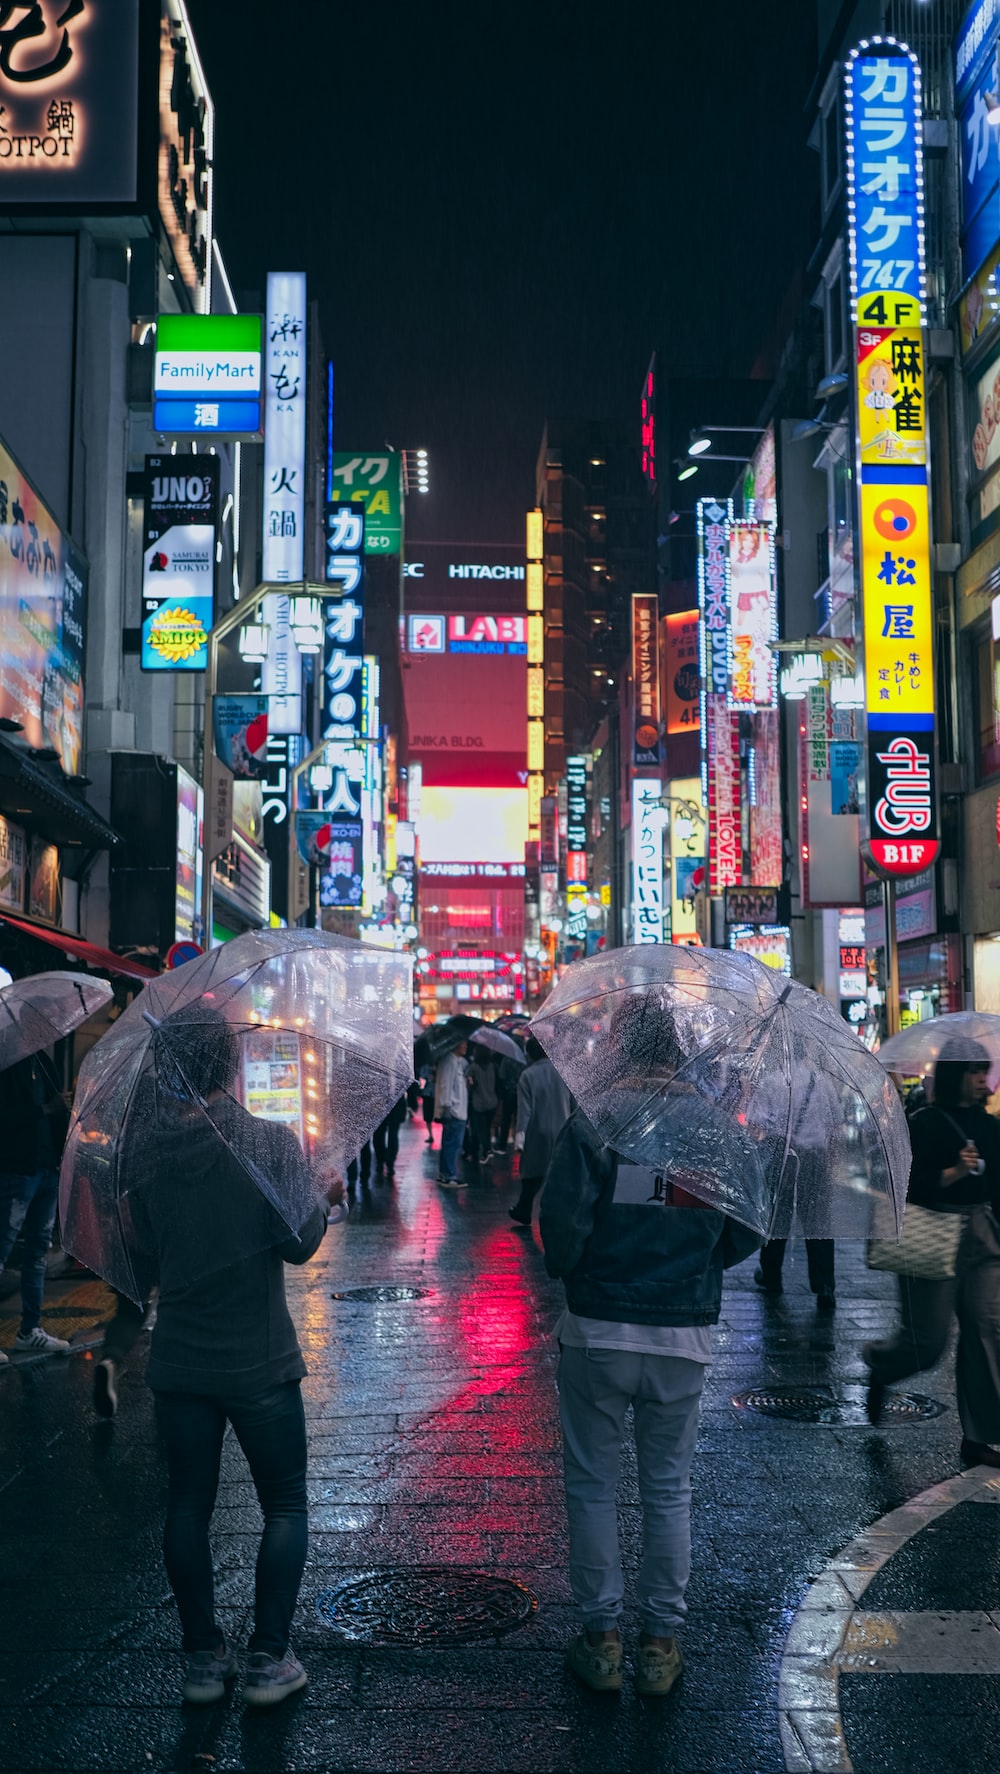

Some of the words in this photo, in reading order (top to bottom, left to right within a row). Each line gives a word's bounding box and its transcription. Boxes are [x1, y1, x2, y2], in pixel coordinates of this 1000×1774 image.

[860, 60, 912, 252] カラオケ
[861, 259, 914, 288] 747
[273, 350, 299, 358] KAN
[860, 333, 882, 347] 3F
[160, 362, 255, 381] FamilyMart
[891, 337, 922, 432] 麻雀
[194, 404, 219, 427] 酒
[276, 404, 294, 412] KA
[334, 457, 391, 485] イク
[268, 467, 298, 538] 火鍋
[148, 531, 159, 539] B1
[449, 564, 525, 580] HITACHI
[705, 523, 726, 630] ホテルがライバル
[146, 602, 159, 610] B2
[877, 551, 916, 639] 松屋
[147, 631, 208, 646] AMICO
[878, 669, 890, 700] 定食
[894, 660, 905, 695] カレー
[908, 652, 921, 690] 牛めし
[875, 737, 931, 836] HUB
[883, 845, 924, 863] B1F
